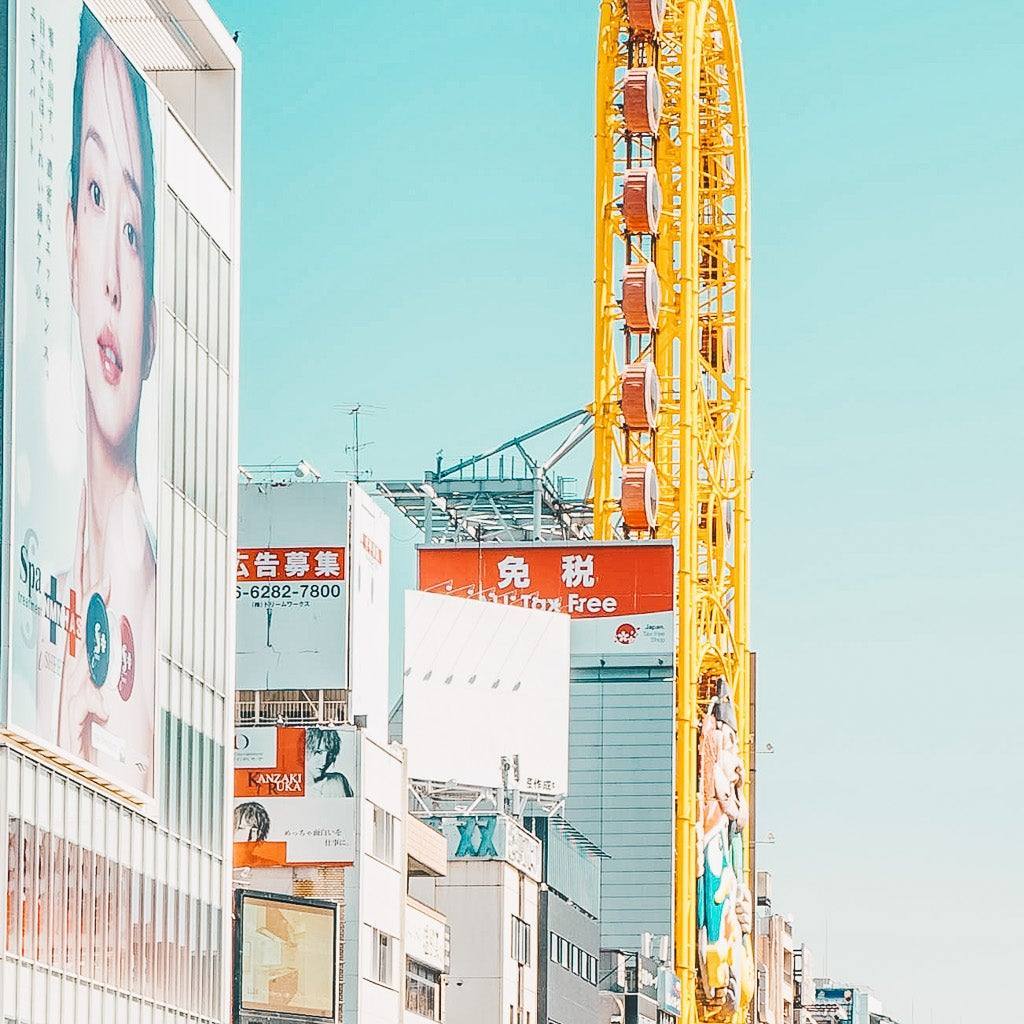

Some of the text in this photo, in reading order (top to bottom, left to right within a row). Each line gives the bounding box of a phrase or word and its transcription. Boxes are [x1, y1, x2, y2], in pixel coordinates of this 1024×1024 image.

[20, 545, 41, 597] Spa
[497, 555, 595, 588] 免税
[568, 593, 617, 613] Free
[248, 771, 302, 787] KANZAKI
[268, 780, 302, 795] RUKA
